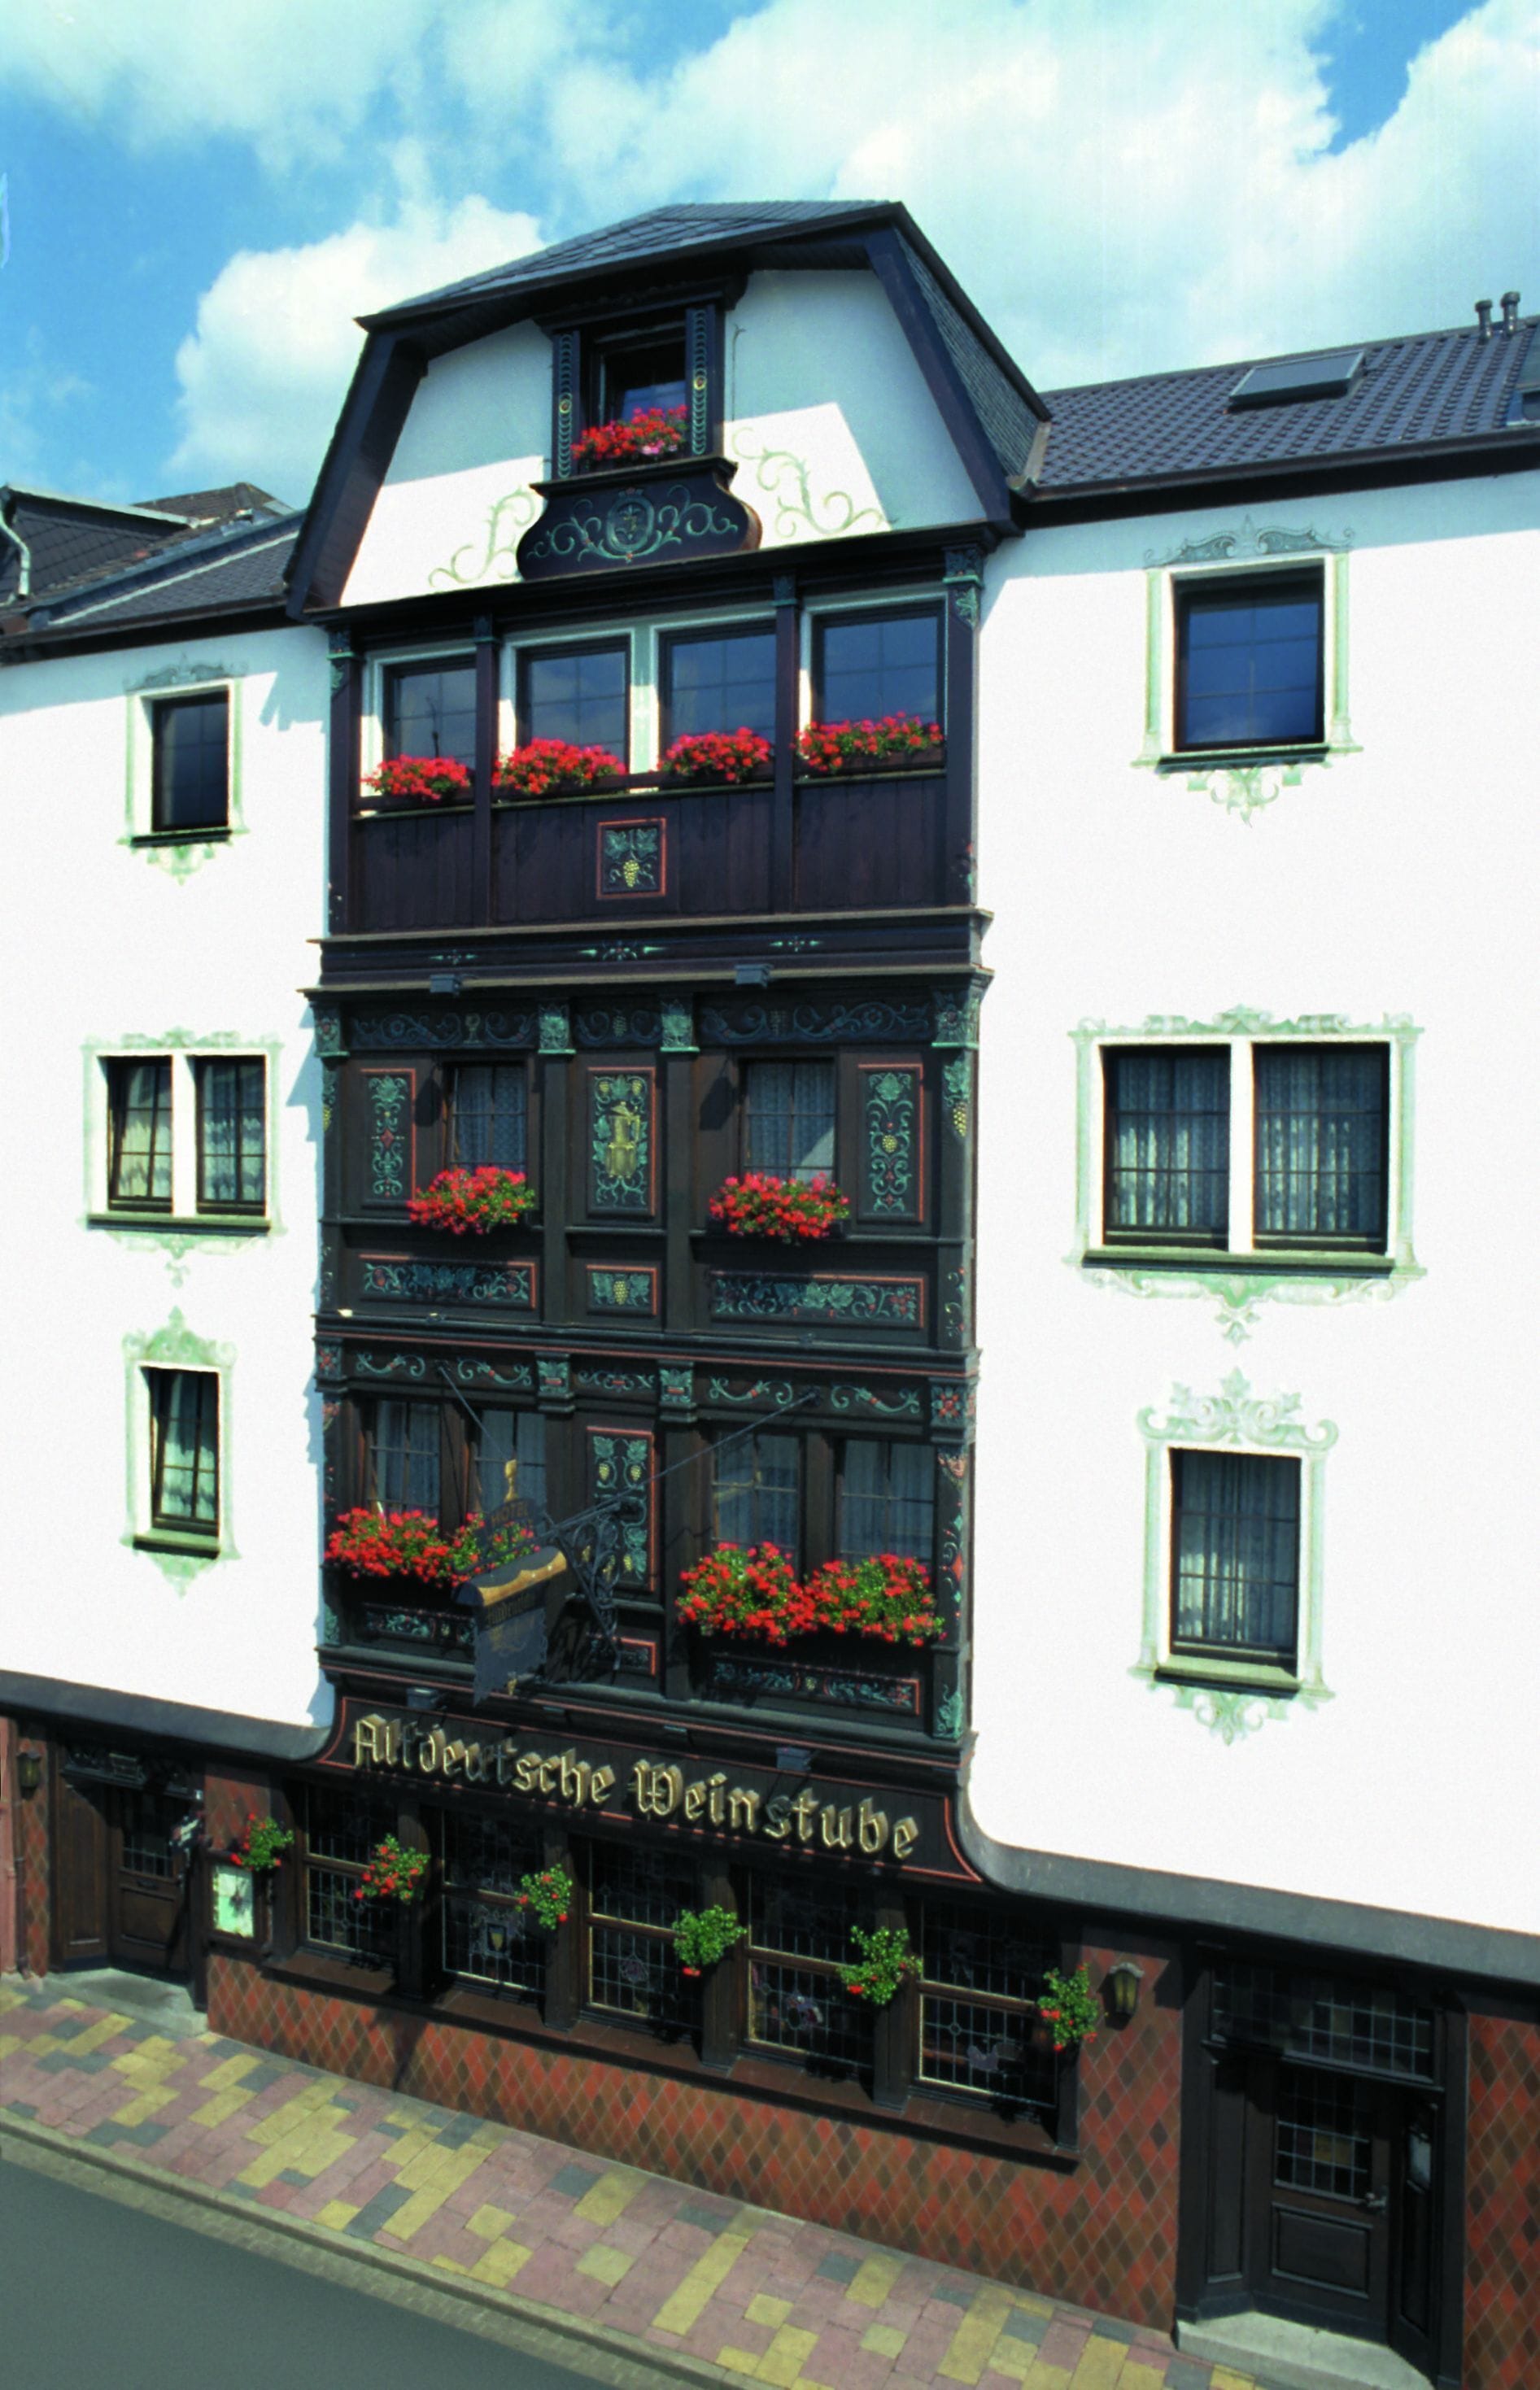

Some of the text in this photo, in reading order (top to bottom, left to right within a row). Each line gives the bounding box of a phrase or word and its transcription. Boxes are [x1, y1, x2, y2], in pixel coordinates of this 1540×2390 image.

[491, 1503, 529, 1527] HOTEL
[352, 1713, 919, 1860] Altdeutsche Weinstube
